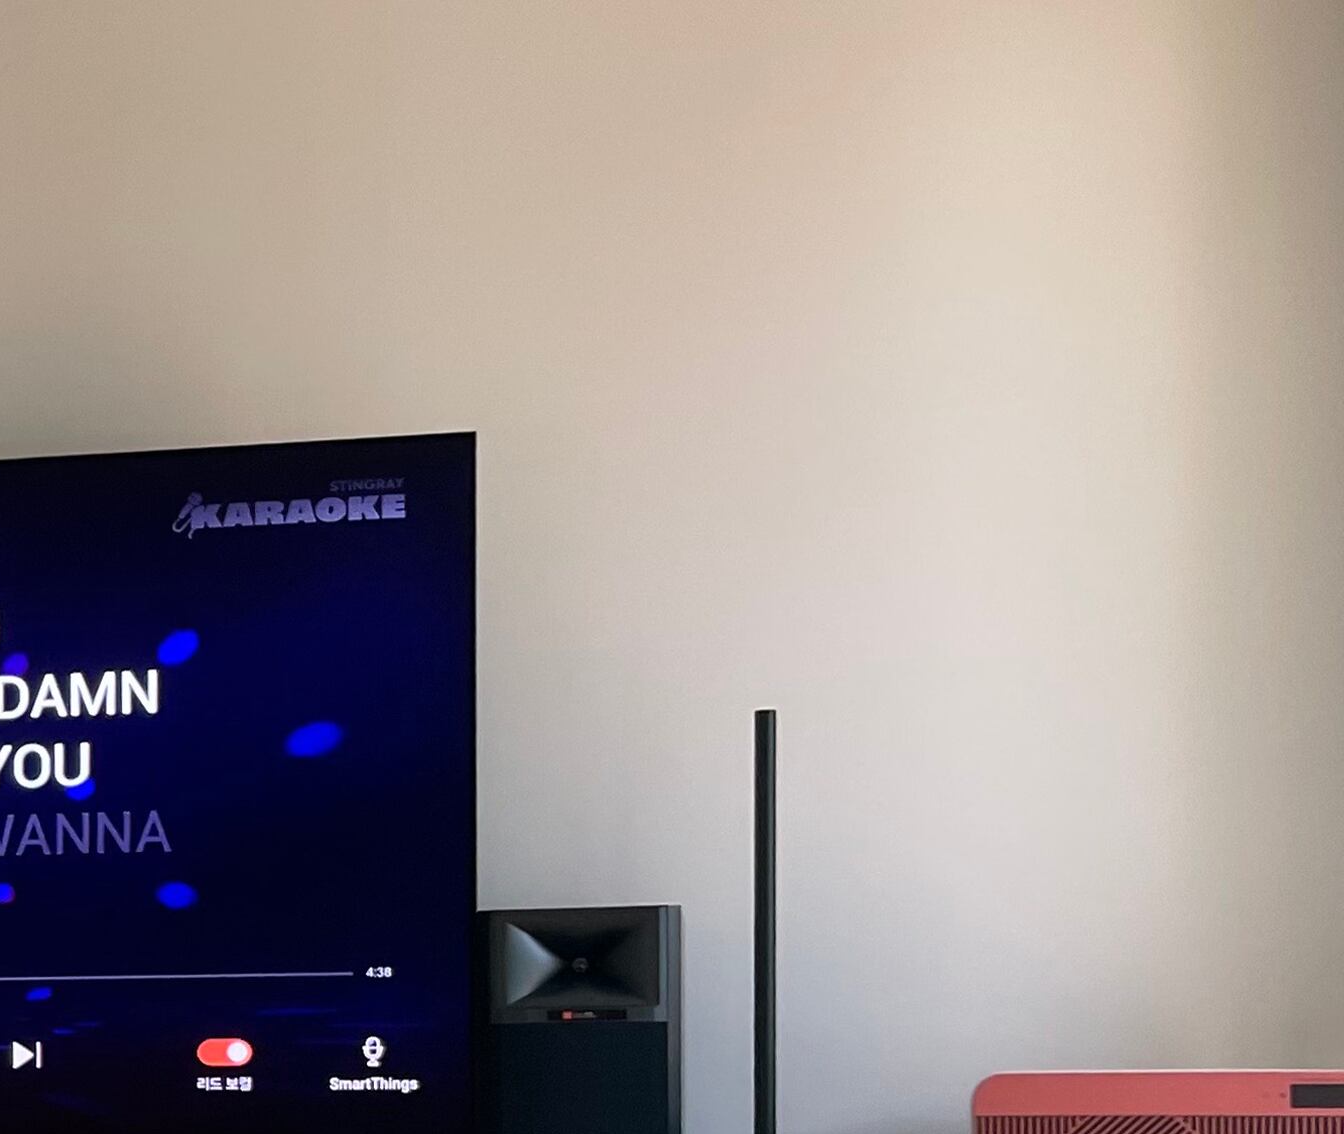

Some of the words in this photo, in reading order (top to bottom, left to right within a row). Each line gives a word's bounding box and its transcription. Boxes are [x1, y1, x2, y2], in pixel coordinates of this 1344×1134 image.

[329, 477, 406, 492] STINGRAY
[190, 494, 407, 529] KARAOKE
[365, 966, 393, 978] 4:38
[196, 1076, 223, 1091] 리드
[328, 1076, 419, 1094] SmartThings
